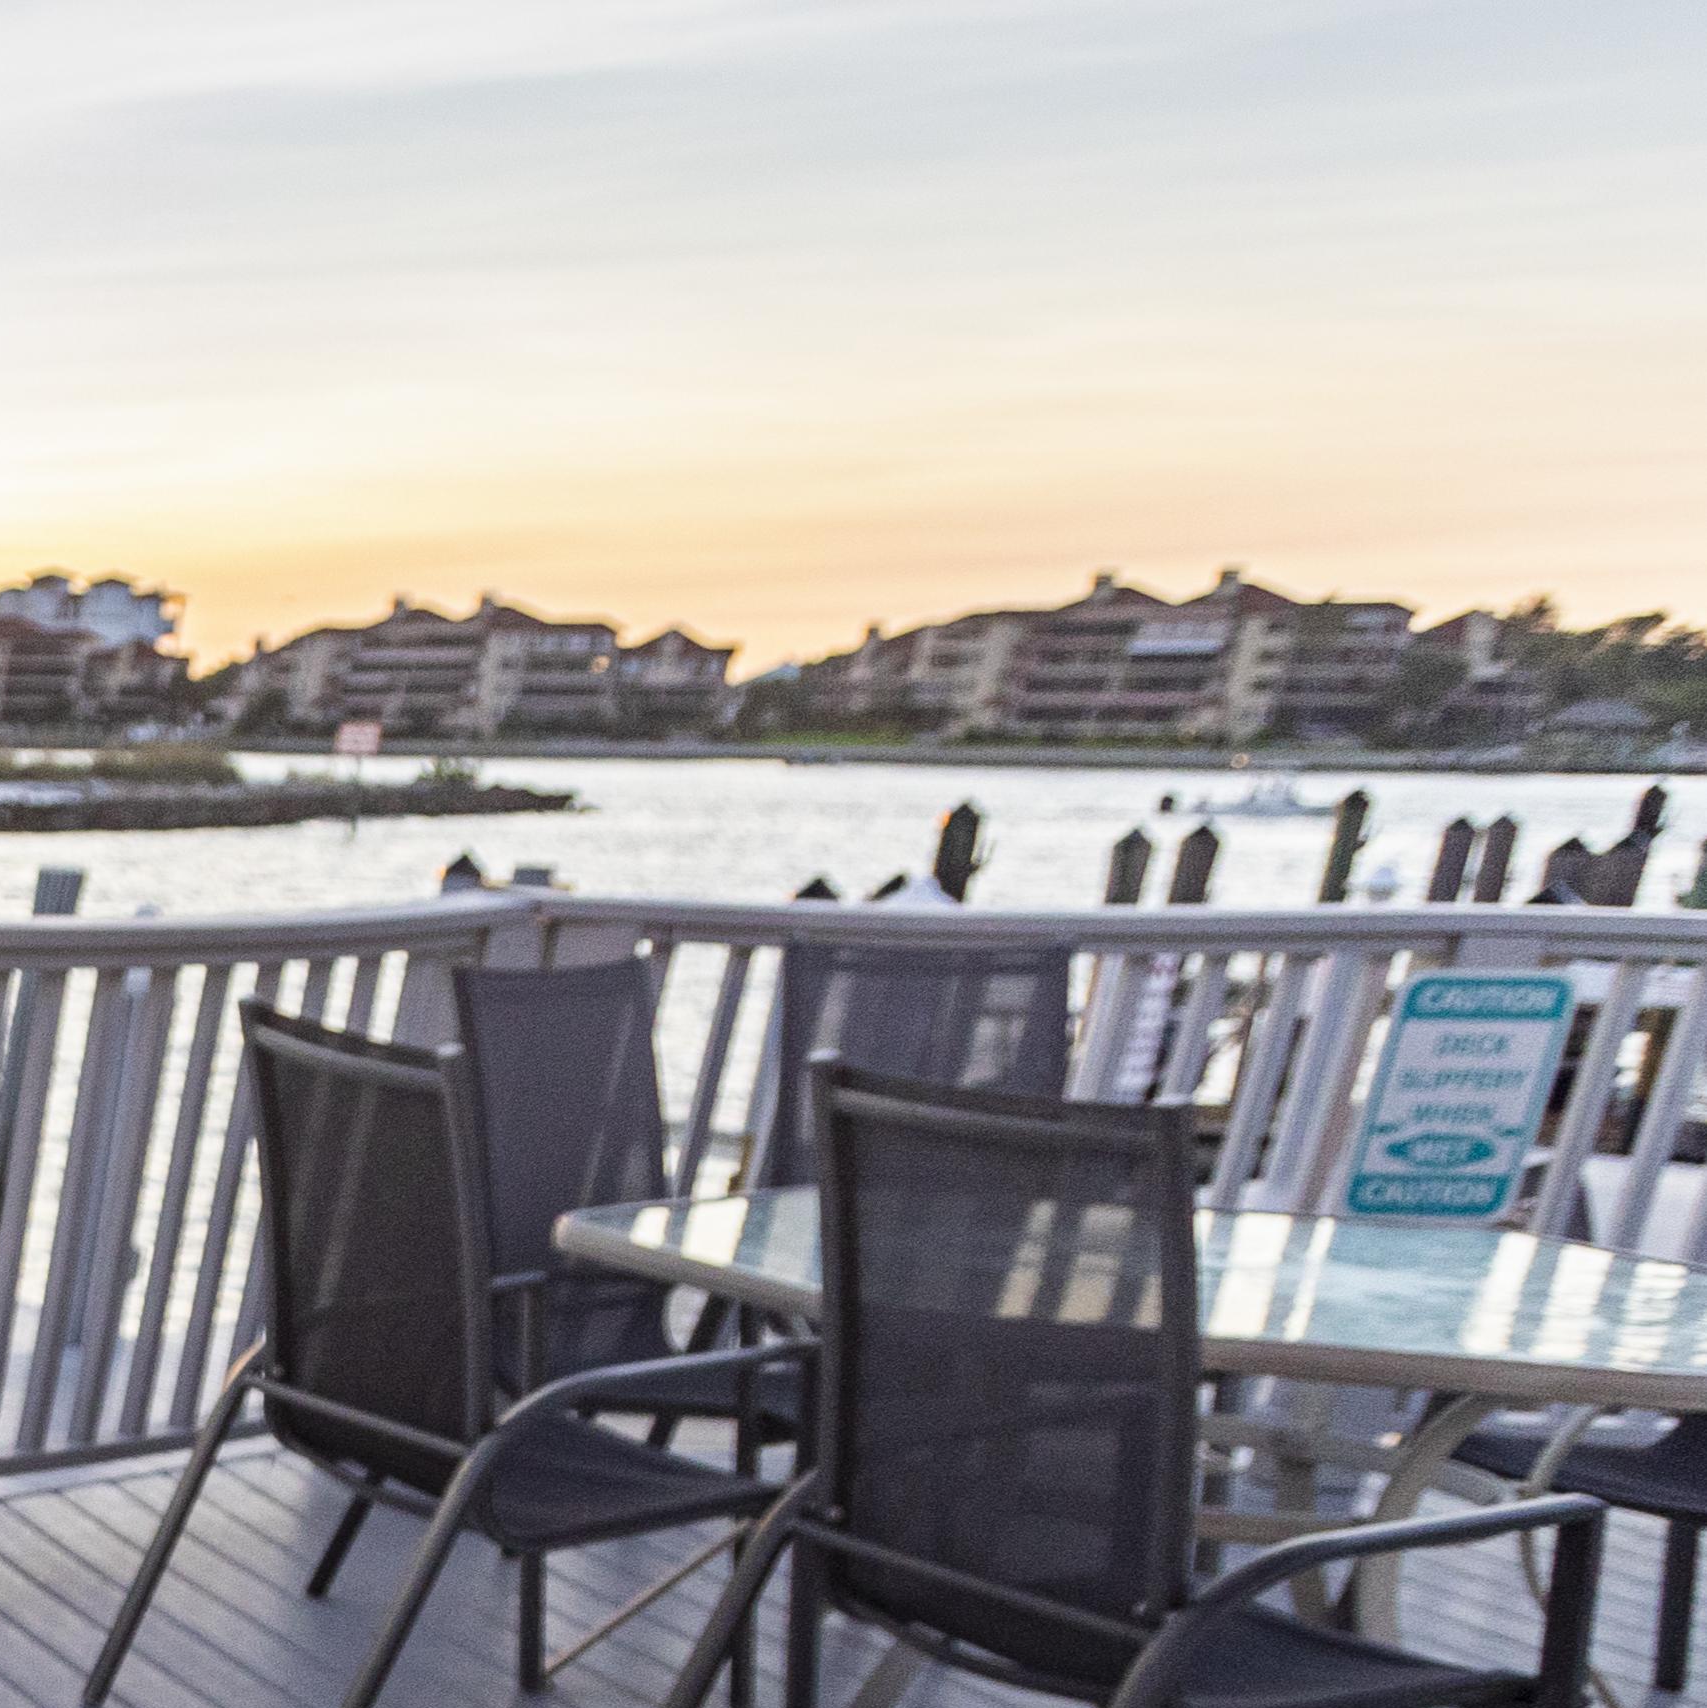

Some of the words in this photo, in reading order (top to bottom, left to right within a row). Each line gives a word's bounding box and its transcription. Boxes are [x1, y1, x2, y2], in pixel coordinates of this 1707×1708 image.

[1423, 986, 1557, 1011] CAUTION
[1434, 1033, 1512, 1055] DECK
[1399, 1068, 1528, 1089] SLIPPERY
[1412, 1104, 1495, 1123] WHEN
[1410, 1141, 1472, 1163] WET
[1363, 1180, 1493, 1203] CAUTION
